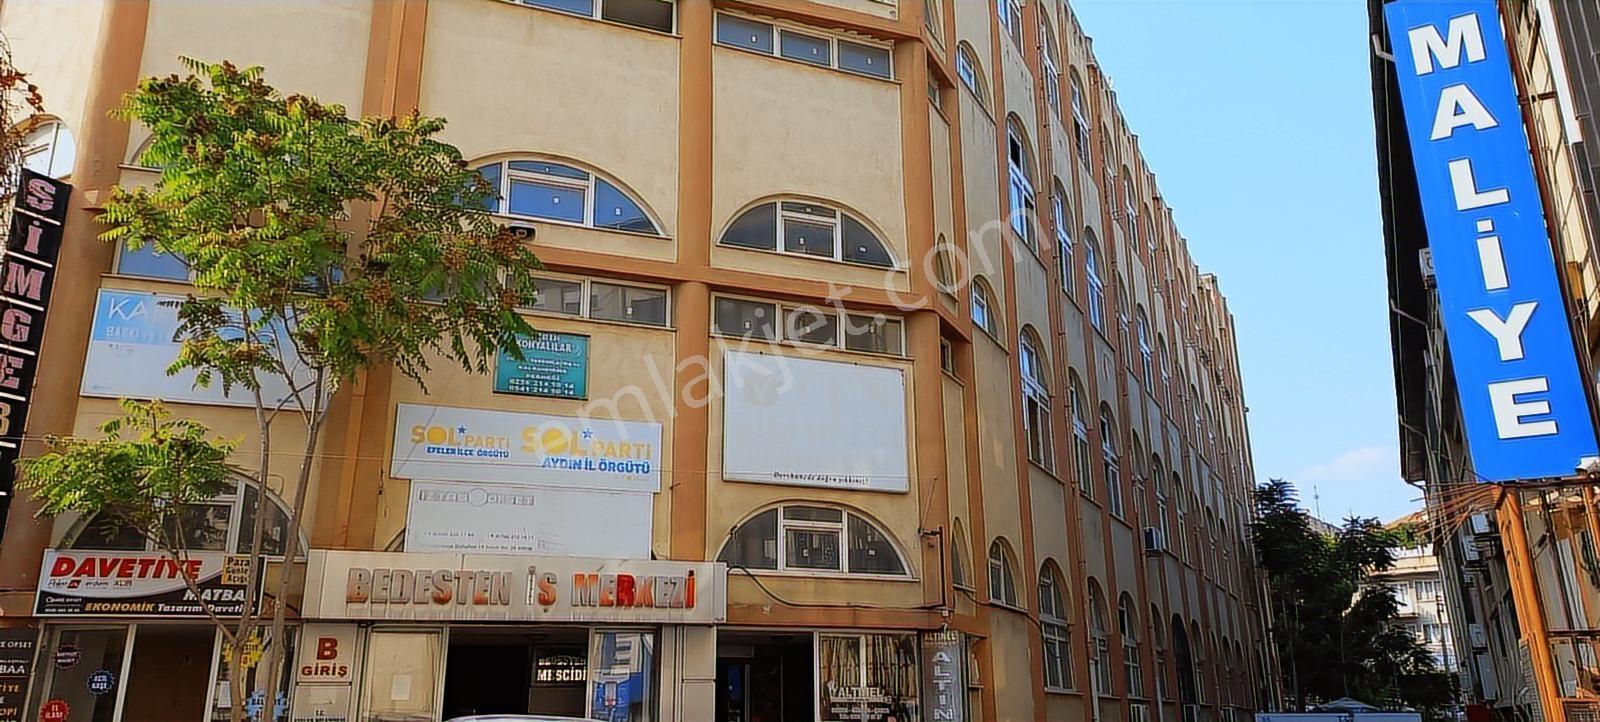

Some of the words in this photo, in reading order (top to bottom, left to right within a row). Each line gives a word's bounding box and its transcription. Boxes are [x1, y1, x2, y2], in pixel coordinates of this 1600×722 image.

[1407, 11, 1559, 440] MALİYE
[411, 424, 459, 447] SOL
[521, 424, 588, 457] SOL
[542, 457, 583, 470] AYDIN
[598, 458, 651, 475] ÖRGÜTÜ
[50, 555, 204, 580] DAVETİYE
[182, 588, 256, 601] MATBA
[345, 567, 513, 606] BEDESTEN
[524, 565, 558, 613] İŞ
[571, 569, 698, 609] MERKEZİ
[84, 601, 156, 613] EKONOMİK
[316, 637, 339, 661] B
[301, 662, 348, 678] GİRİŞ
[536, 666, 587, 681] MESCİDİ
